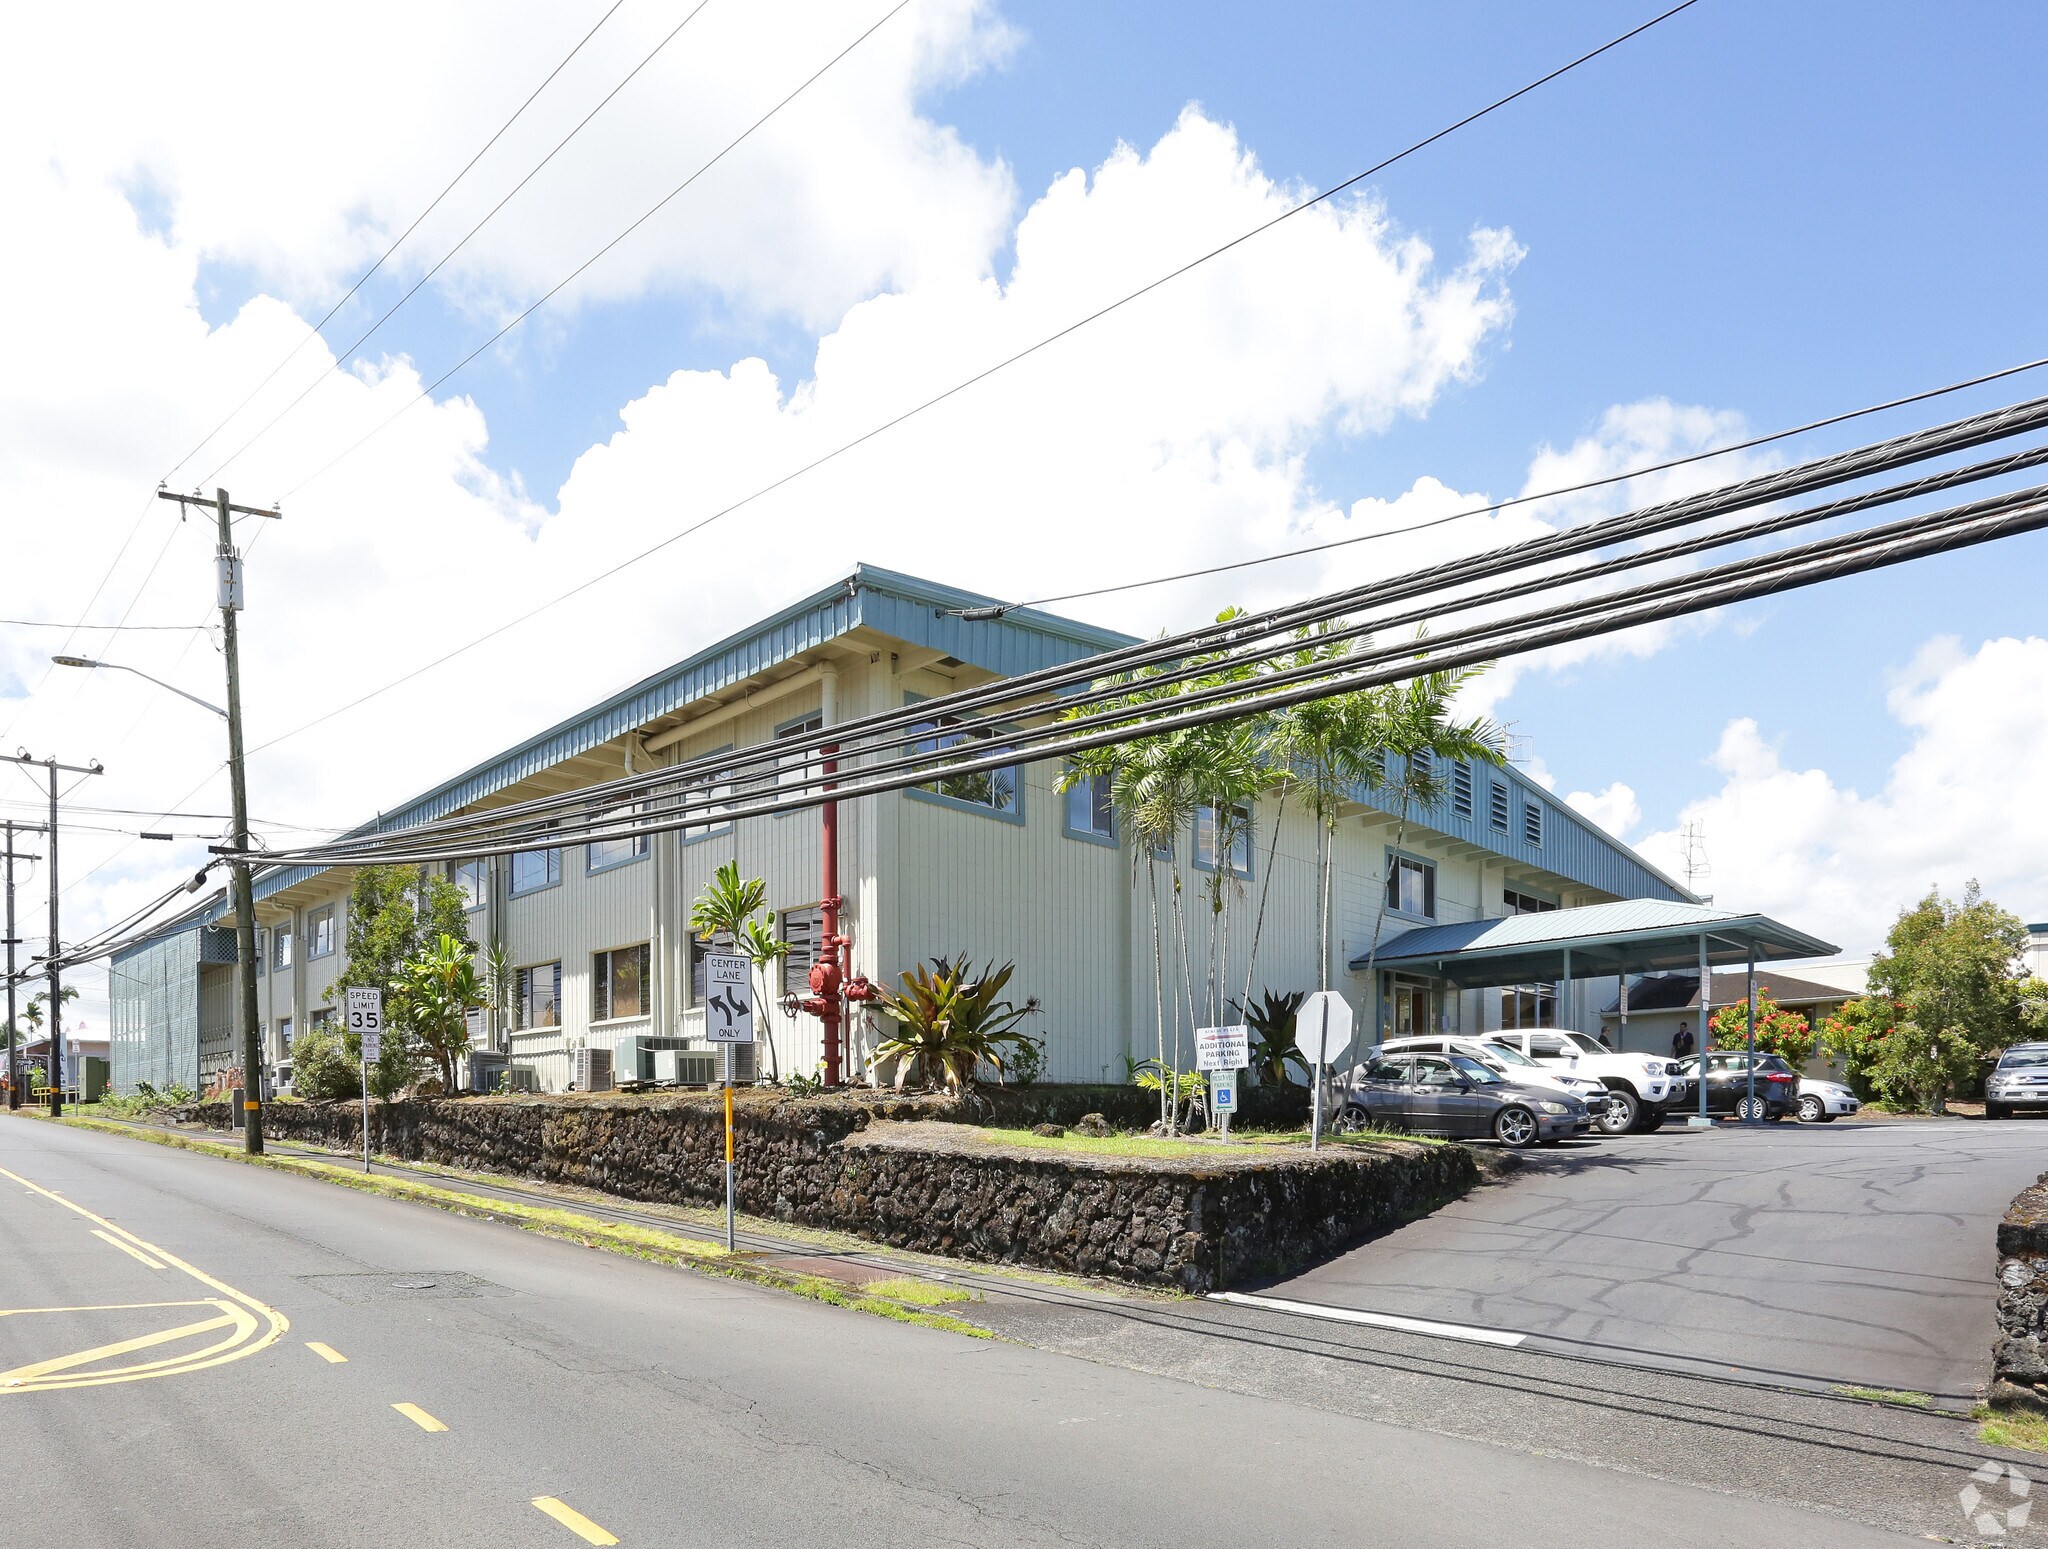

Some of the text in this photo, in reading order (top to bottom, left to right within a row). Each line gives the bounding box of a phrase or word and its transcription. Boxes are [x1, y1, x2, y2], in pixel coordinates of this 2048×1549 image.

[711, 959, 746, 969] CENTER
[717, 971, 741, 980] LANE
[350, 991, 378, 1000] SPEED
[351, 1012, 378, 1028] 35
[718, 1028, 741, 1038] ONLY
[1199, 1041, 1246, 1050] ADDITIONAL
[1205, 1050, 1240, 1058] PARKING
[1223, 1058, 1243, 1067] Right
